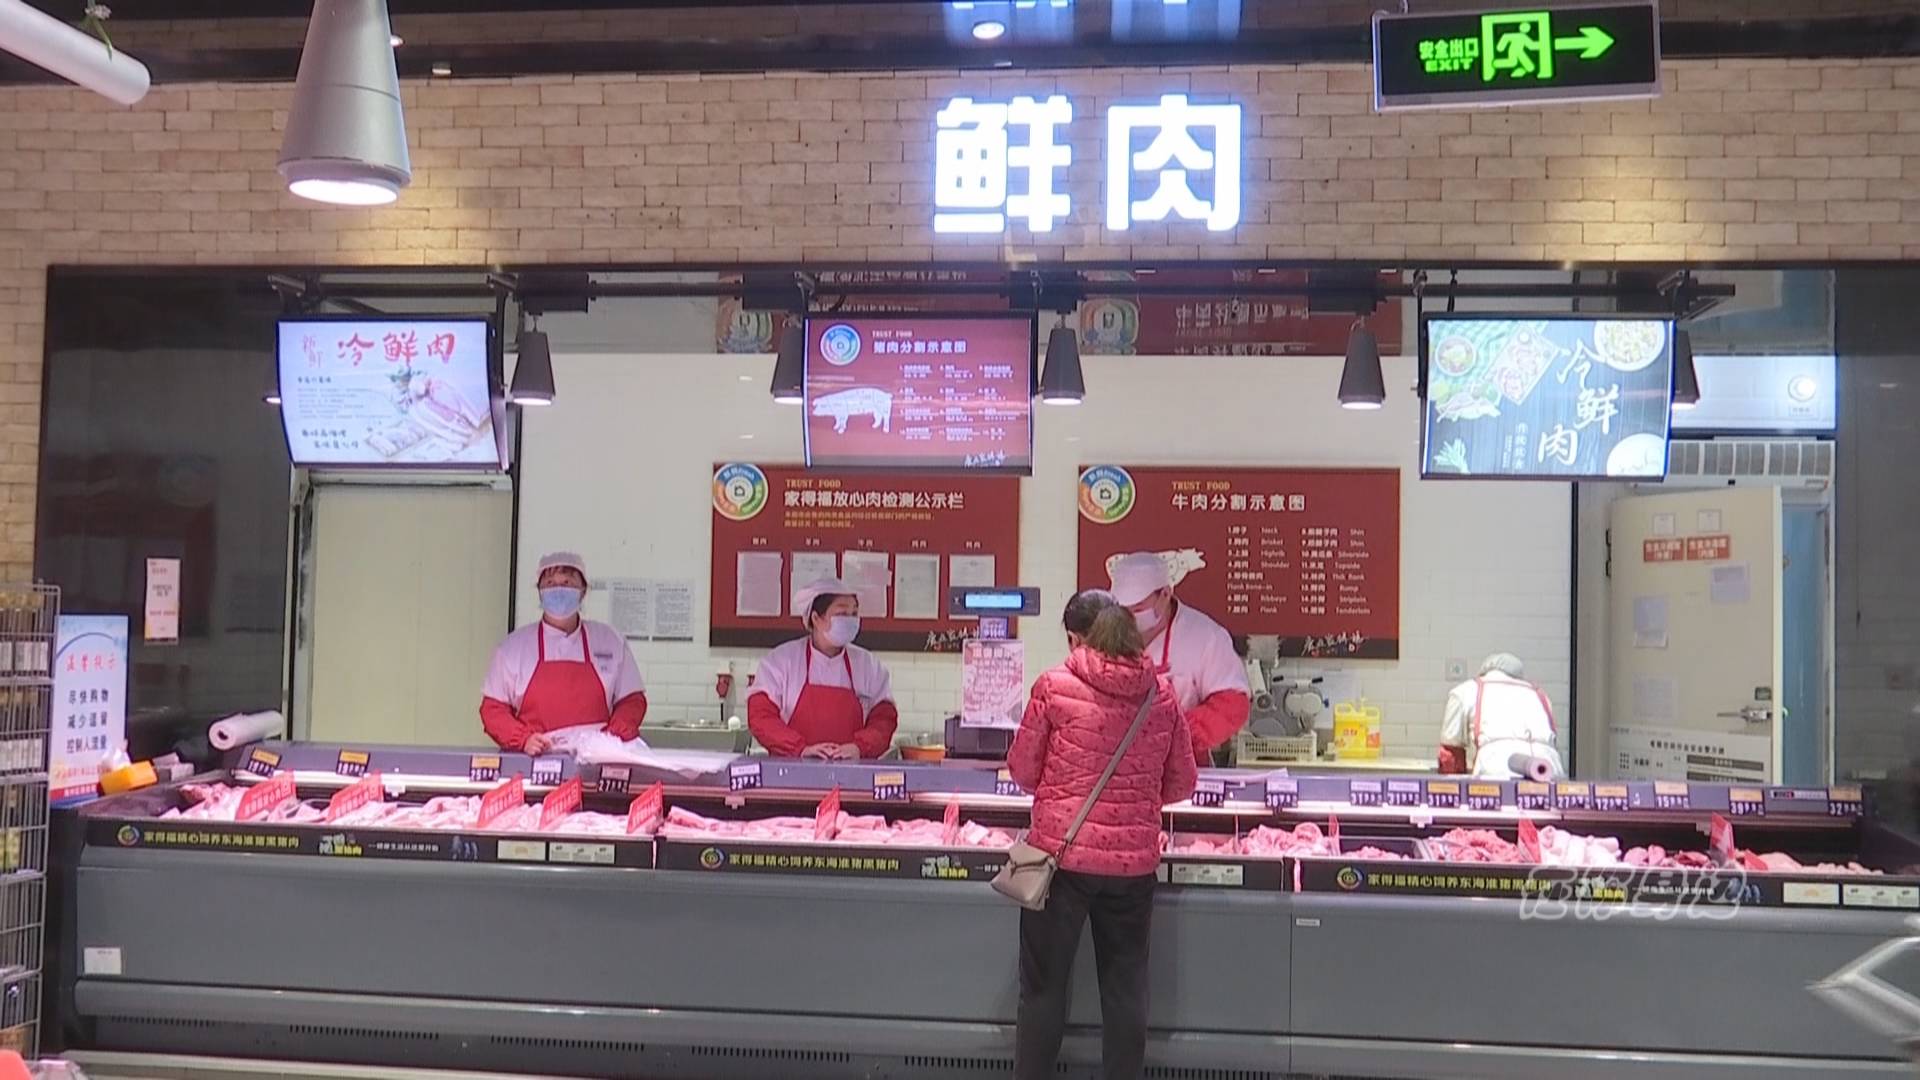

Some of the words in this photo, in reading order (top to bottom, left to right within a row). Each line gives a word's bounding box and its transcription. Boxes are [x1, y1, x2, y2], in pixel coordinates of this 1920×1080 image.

[1419, 38, 1479, 60] 安全出口
[1425, 58, 1474, 73] EXIT
[933, 94, 1242, 233] 鲜肉
[337, 329, 456, 367] 冷鲜肉
[873, 340, 967, 354] 猪肉分割示意图
[1537, 337, 1620, 466] 冷鲜肉
[785, 478, 813, 488] TRUST
[818, 479, 842, 488] FOOD
[1172, 481, 1201, 491] TRUST
[1206, 481, 1230, 491] FOOD
[784, 490, 964, 510] 家得福放心肉检测公示栏
[1172, 493, 1306, 512] 牛肉分割示意图
[69, 688, 109, 705] 尽快购物
[66, 735, 108, 754] 控制人流量
